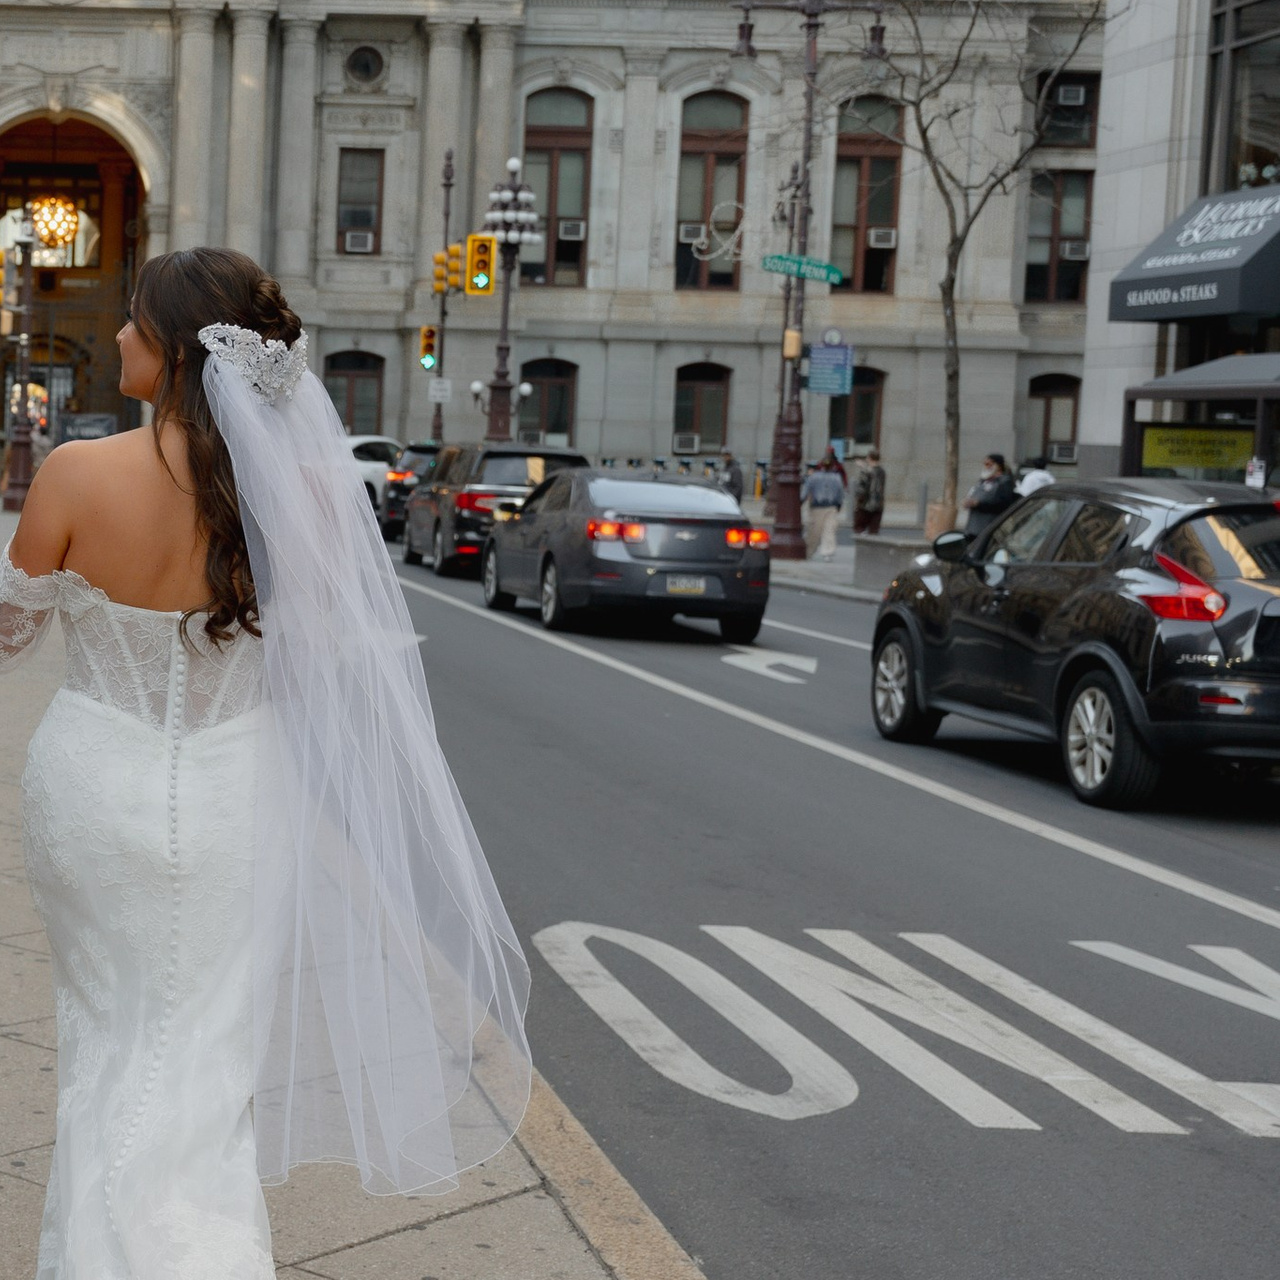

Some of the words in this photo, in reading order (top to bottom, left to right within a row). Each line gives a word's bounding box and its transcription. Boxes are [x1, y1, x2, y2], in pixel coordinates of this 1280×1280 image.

[765, 258, 798, 276] SOUTH
[800, 265, 827, 279] PENN
[1126, 287, 1171, 307] SEAFOOD
[1171, 289, 1180, 303] &
[1179, 282, 1218, 303] STEAKS
